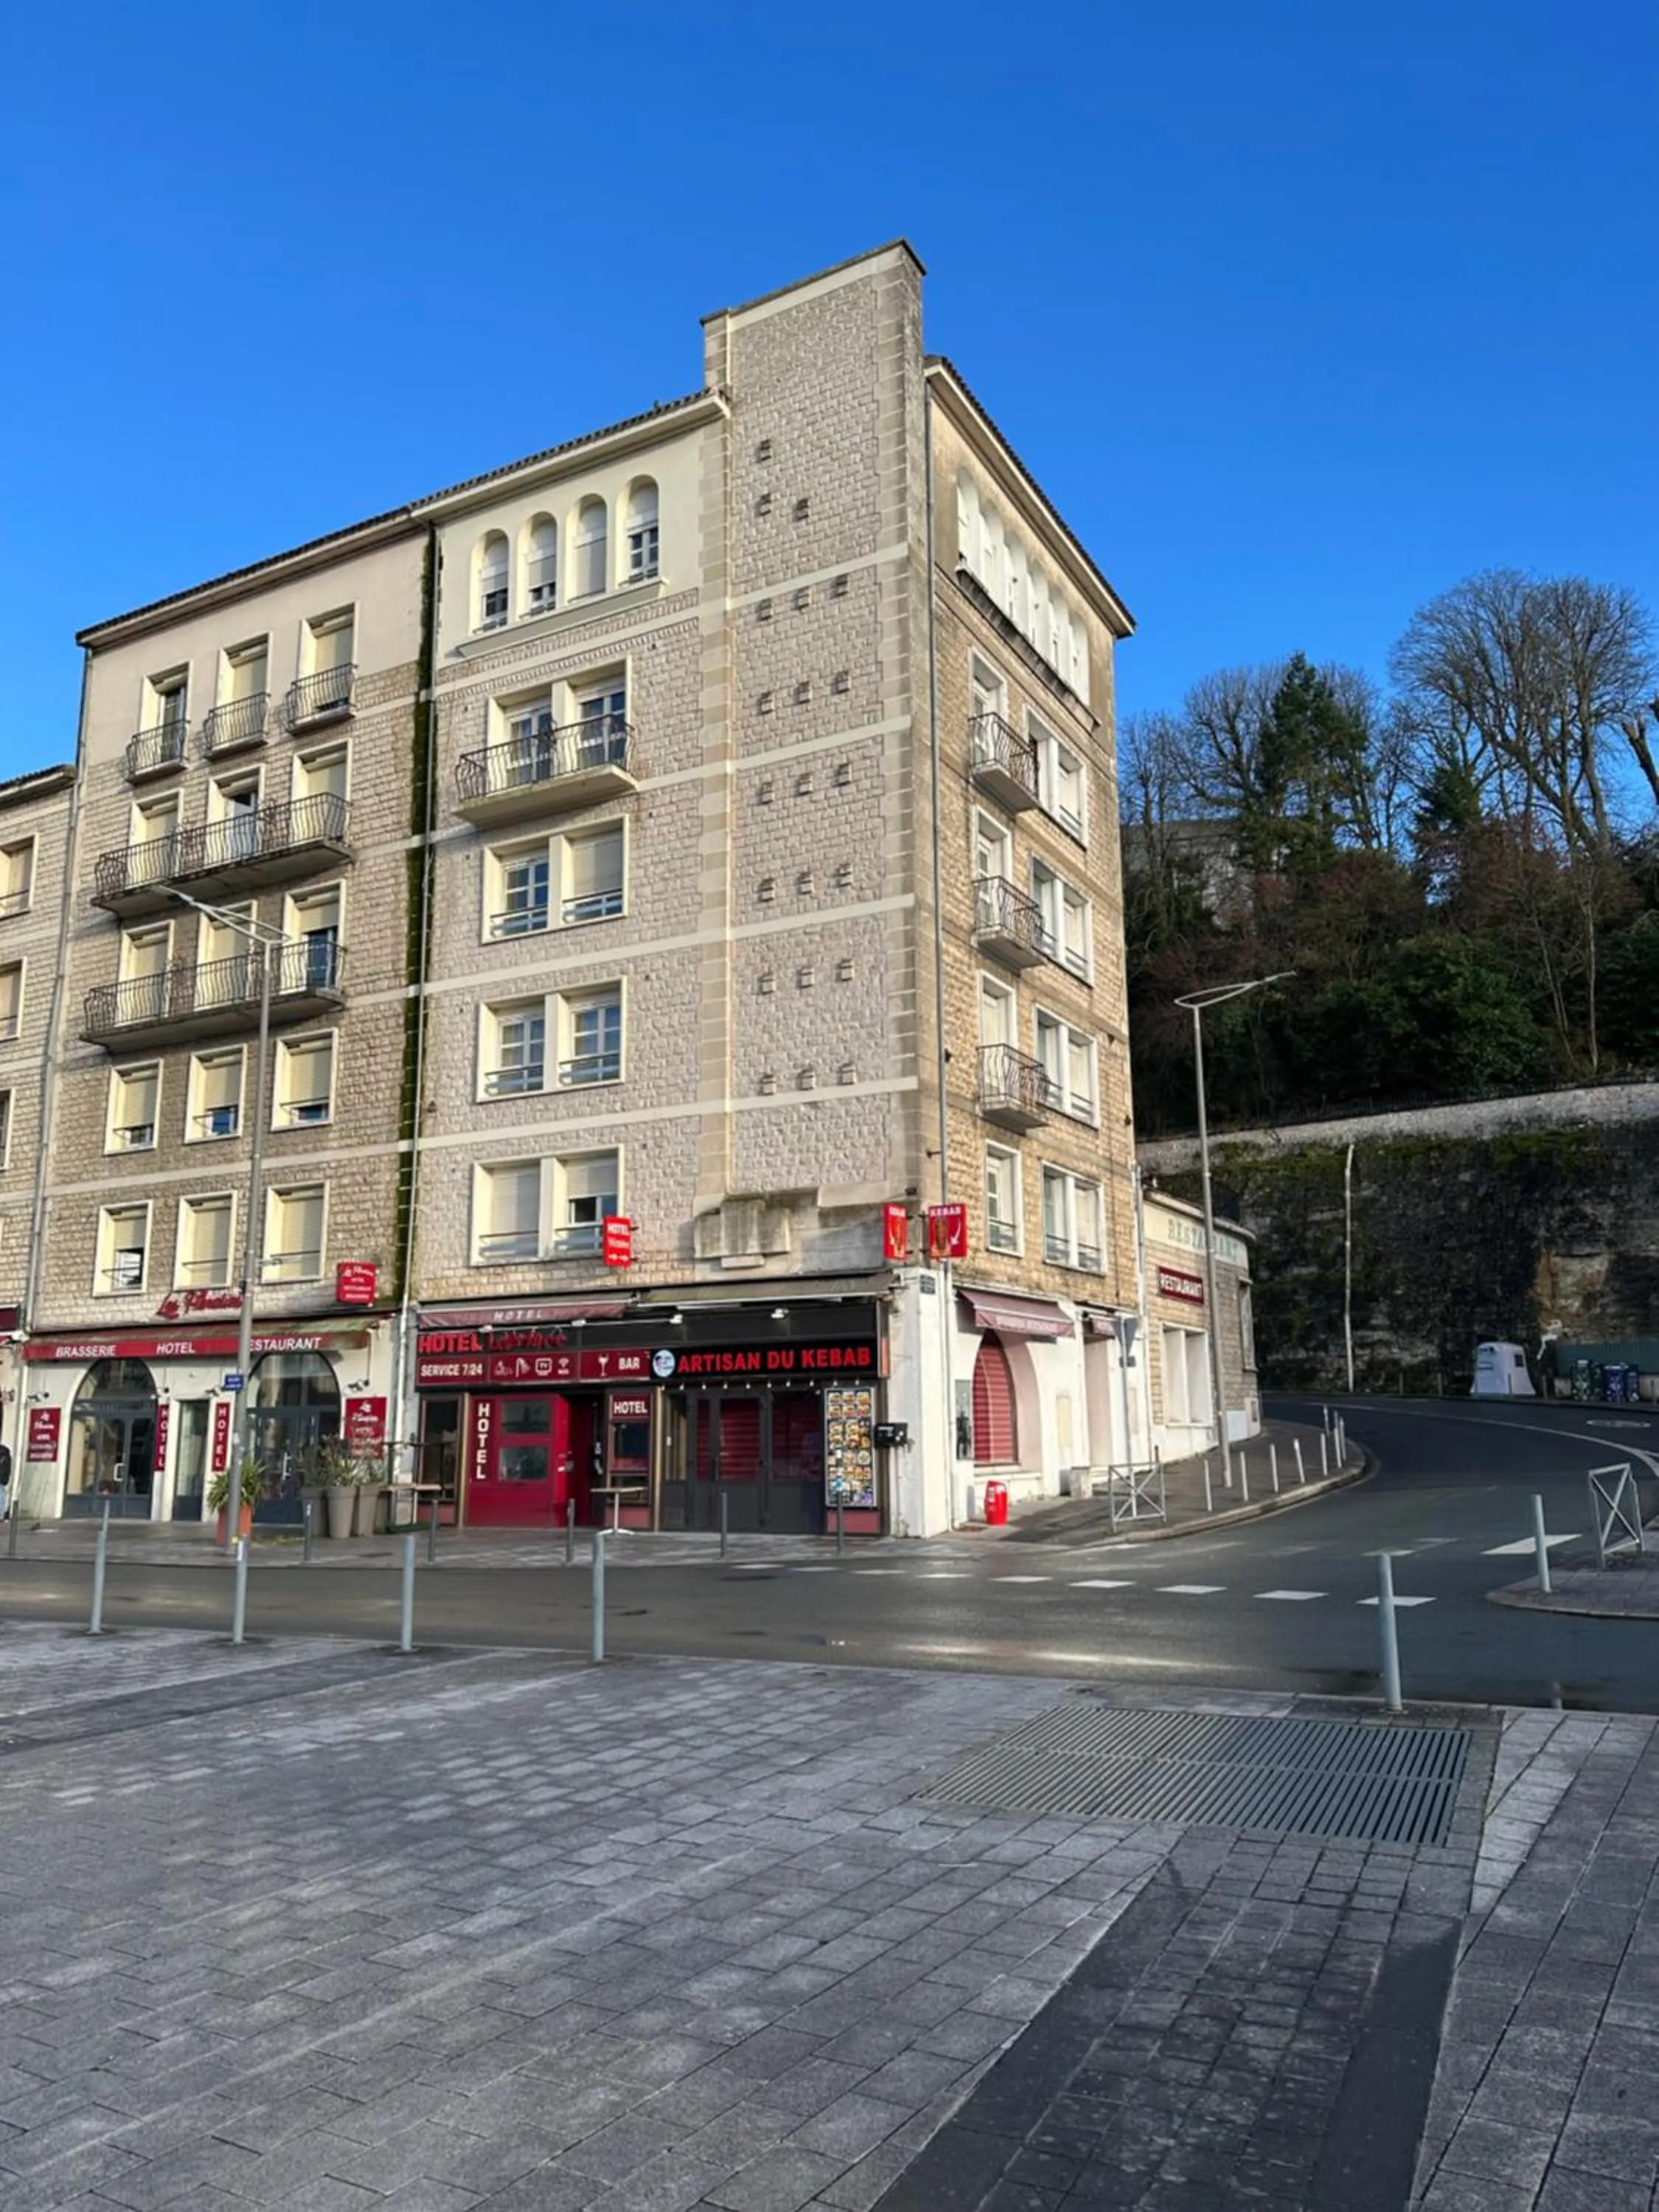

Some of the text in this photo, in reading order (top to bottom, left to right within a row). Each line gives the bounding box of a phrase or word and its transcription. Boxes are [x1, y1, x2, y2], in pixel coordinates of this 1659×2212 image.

[930, 1206, 961, 1216] KEBAB
[1167, 1218, 1239, 1260] RESTARANT
[493, 1310, 543, 1320] HOTEL
[55, 1336, 323, 1357] BRASSERIE HOTEL ESTAURANT
[419, 1333, 482, 1353] HOTEL
[421, 1363, 459, 1377] SERVICE
[619, 1357, 641, 1370] BAR
[678, 1351, 760, 1372] ARTISAN
[768, 1349, 794, 1369] DU
[801, 1346, 872, 1368] KEBAB
[613, 1401, 648, 1414] HOTEL
[215, 1407, 227, 1467] HOTEL
[478, 1403, 490, 1480] HOTEL
